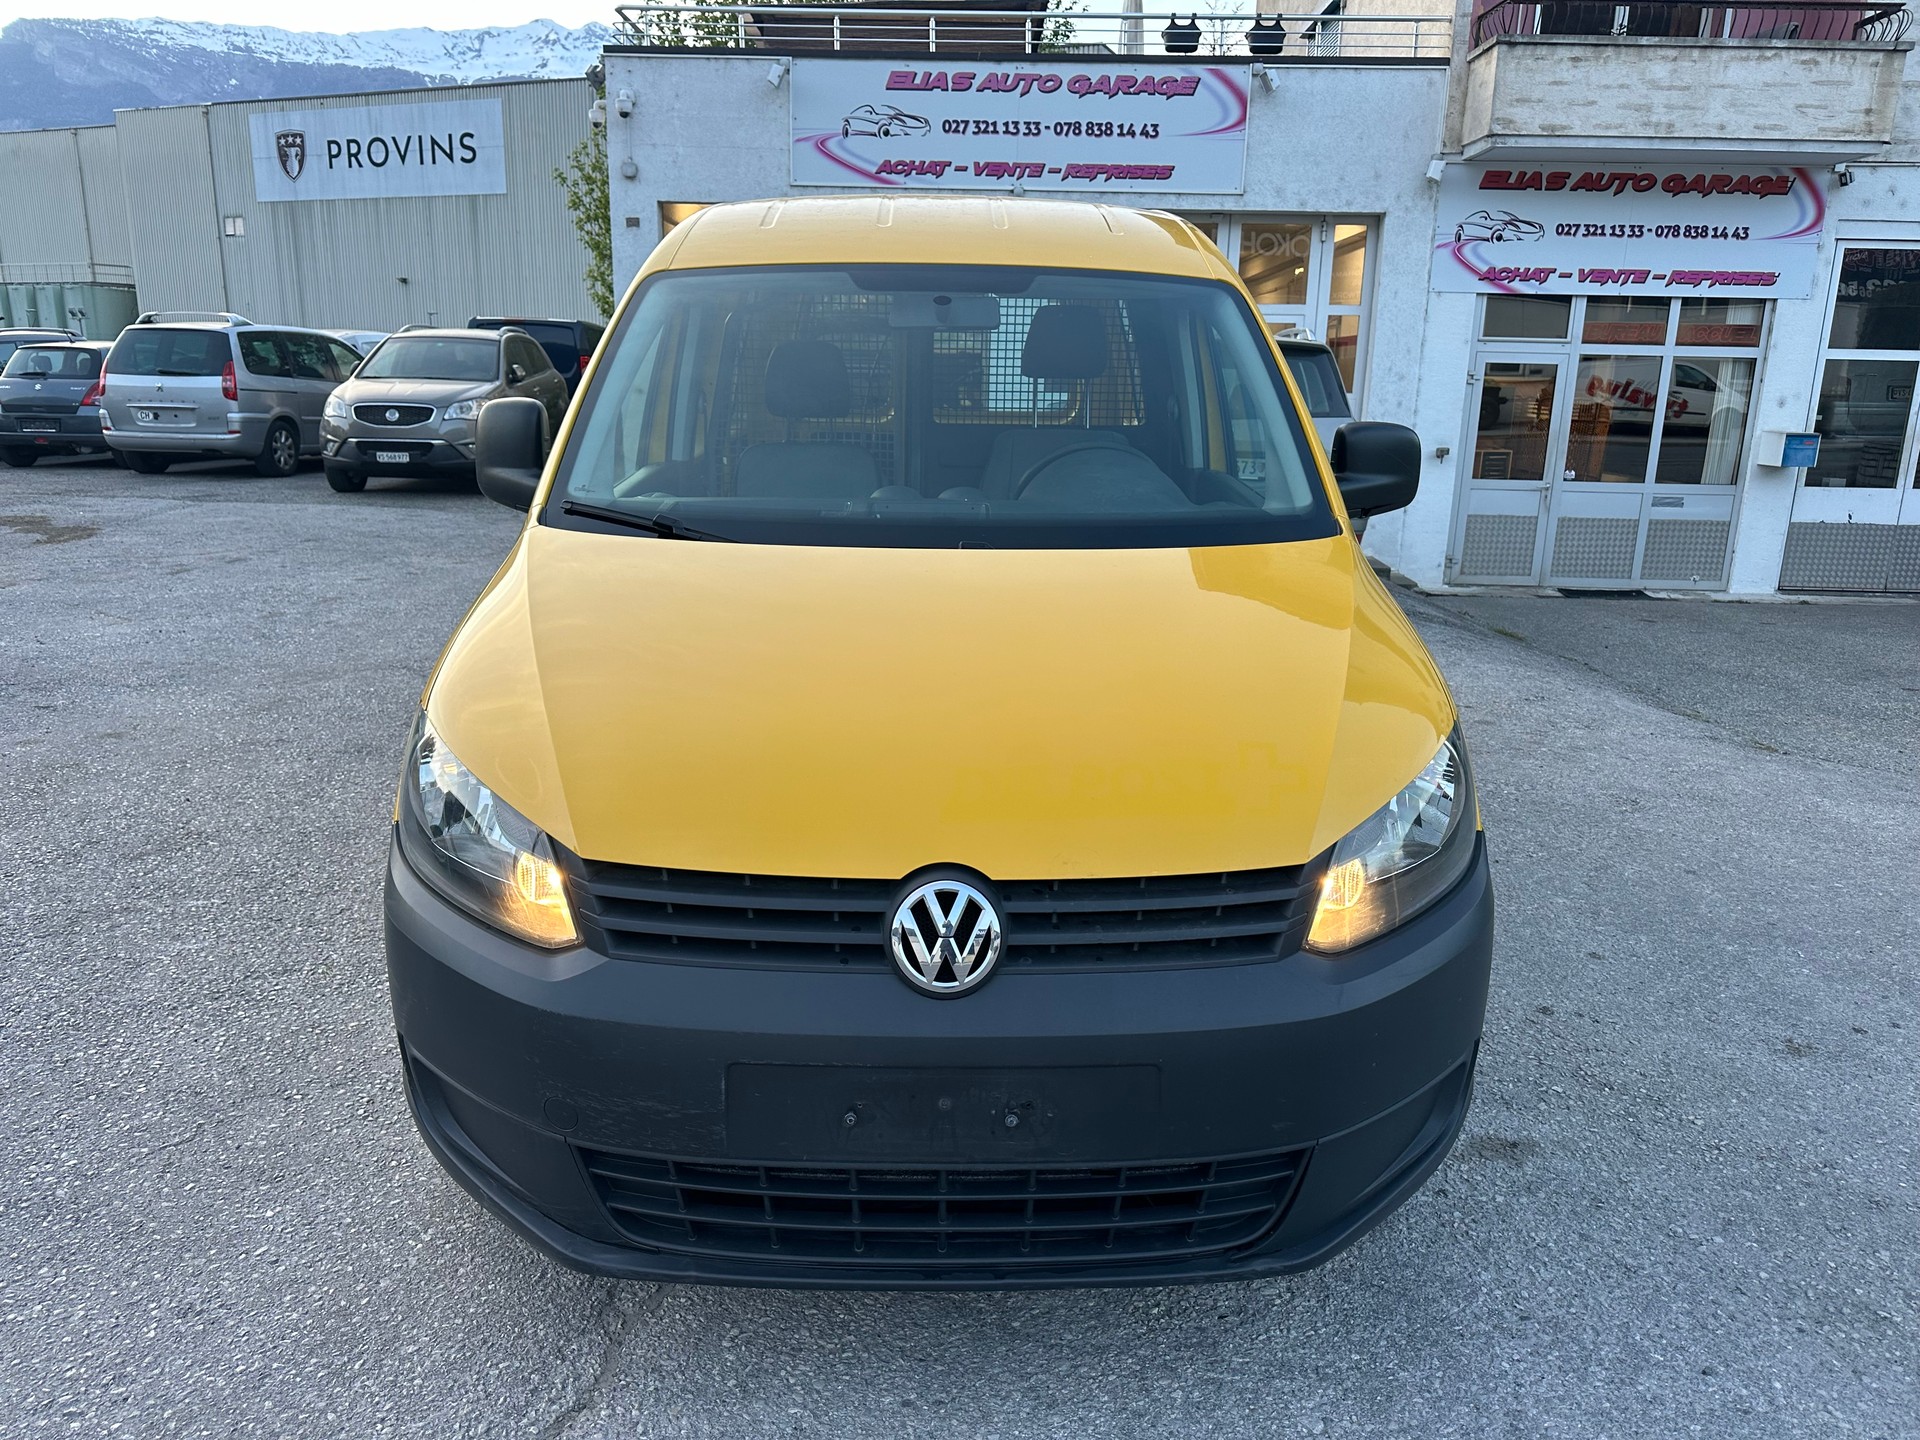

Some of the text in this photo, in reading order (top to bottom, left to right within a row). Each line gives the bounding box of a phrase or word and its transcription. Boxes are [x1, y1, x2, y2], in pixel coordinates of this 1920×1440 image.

[886, 70, 1202, 100] ELIAS AUTO GARAGE
[942, 119, 970, 135] 027
[971, 120, 999, 136] 321
[1001, 120, 1019, 136] 13
[1021, 121, 1042, 137] 33
[1053, 121, 1082, 138] 078
[1083, 122, 1114, 138] 838
[1116, 122, 1136, 139] 14
[1138, 123, 1160, 139] 43
[326, 132, 478, 170] PROVINS
[874, 158, 952, 179] ACHAT
[972, 161, 1046, 180] VENTE
[1060, 162, 1176, 183] REPRISES
[1478, 170, 1798, 199] ELIAS AUTO GARAGE
[1555, 223, 1582, 238] 027
[1582, 224, 1607, 238] 321
[1608, 224, 1625, 239] 13
[1626, 225, 1645, 239] 33
[1653, 225, 1683, 240] 078
[1683, 225, 1710, 240] 838
[1710, 226, 1730, 241] 14
[1730, 226, 1750, 241] 43
[1479, 266, 1557, 285] ACHAT
[1577, 268, 1652, 286] VENTE
[1665, 269, 1781, 288] REPRISES
[1585, 322, 1663, 343] BUREAU
[140, 411, 150, 420] CH
